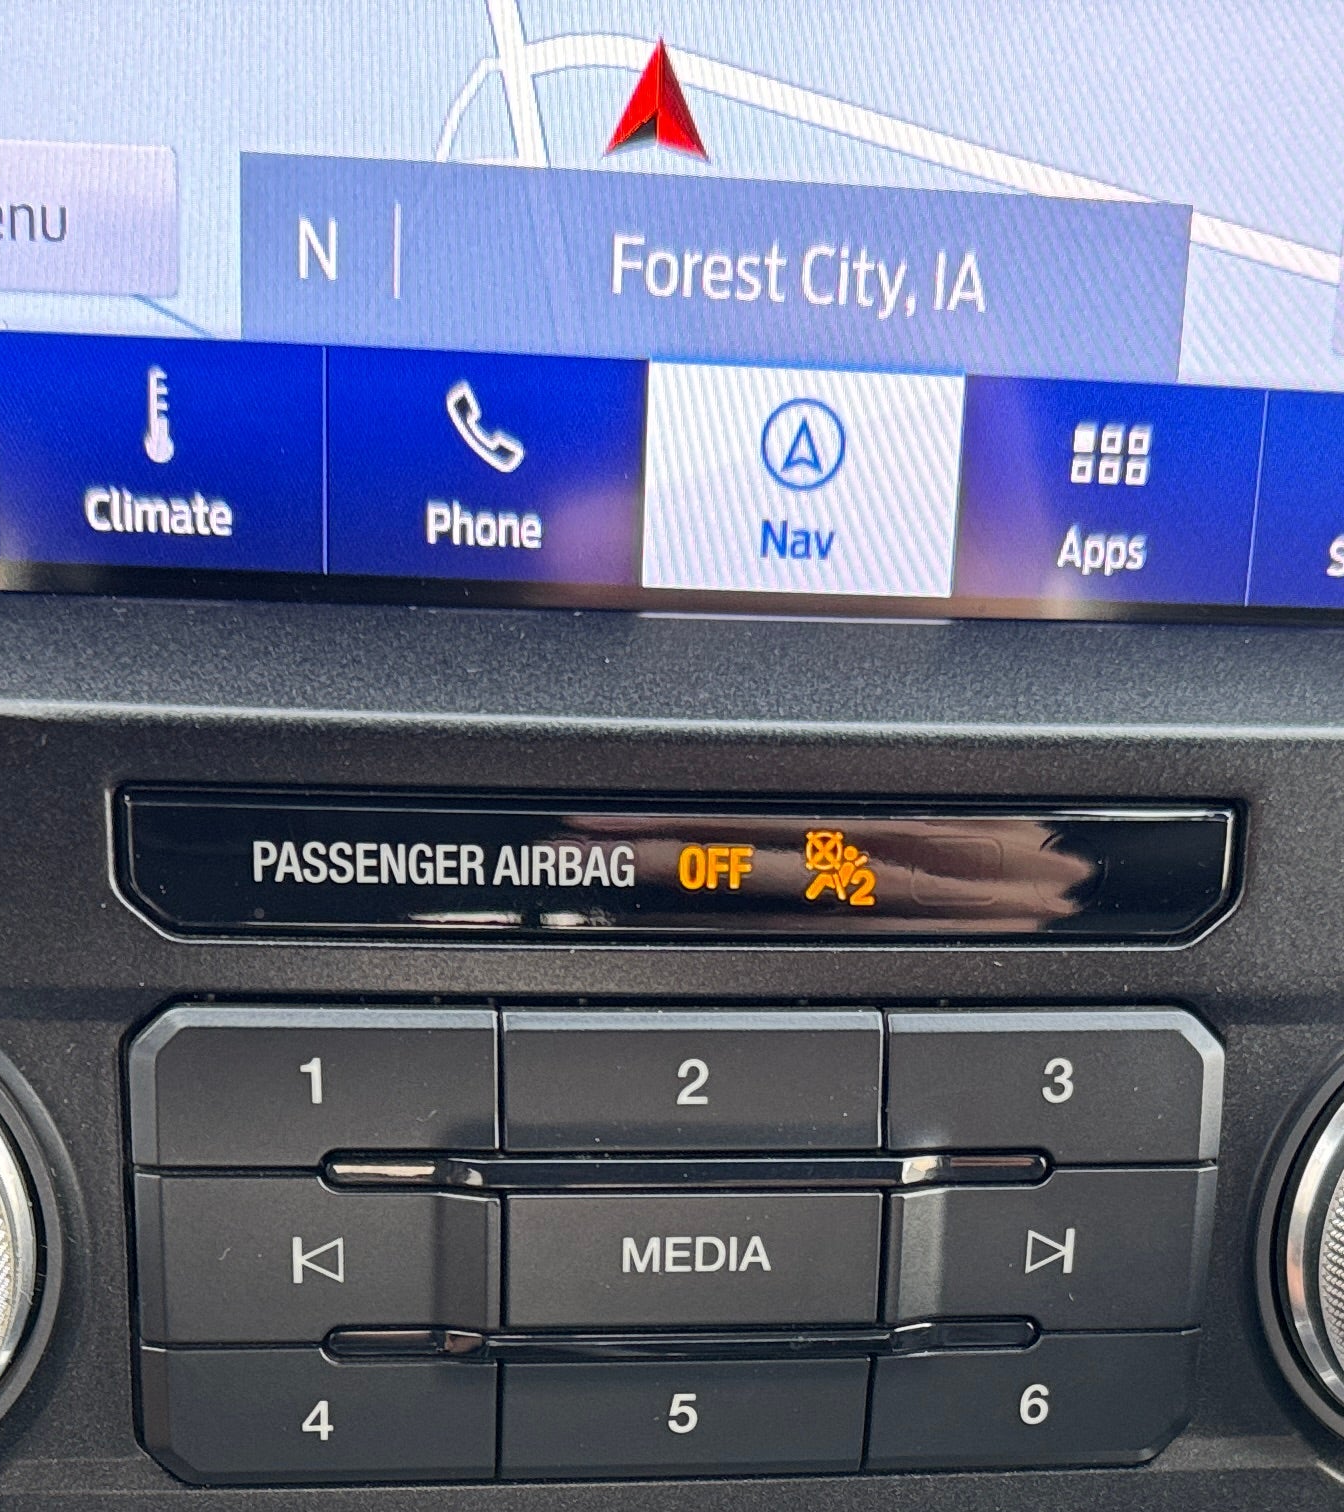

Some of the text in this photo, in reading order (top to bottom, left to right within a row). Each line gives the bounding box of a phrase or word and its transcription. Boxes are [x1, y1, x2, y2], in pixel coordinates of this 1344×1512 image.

[298, 218, 338, 280] N
[611, 234, 987, 320] Forest City, IA
[85, 486, 234, 537] Climate
[427, 500, 543, 550] Phone
[761, 520, 835, 559] Nav
[1057, 525, 1147, 576] Apps
[253, 840, 753, 890] PASSENGER AIRBAG OFF
[300, 1058, 324, 1103] 1
[678, 1060, 708, 1105] 2
[1042, 1058, 1074, 1102] 3
[621, 1236, 771, 1273] MEDIA
[300, 1402, 334, 1441] 4
[668, 1393, 698, 1434] 5
[1018, 1384, 1050, 1427] 6
